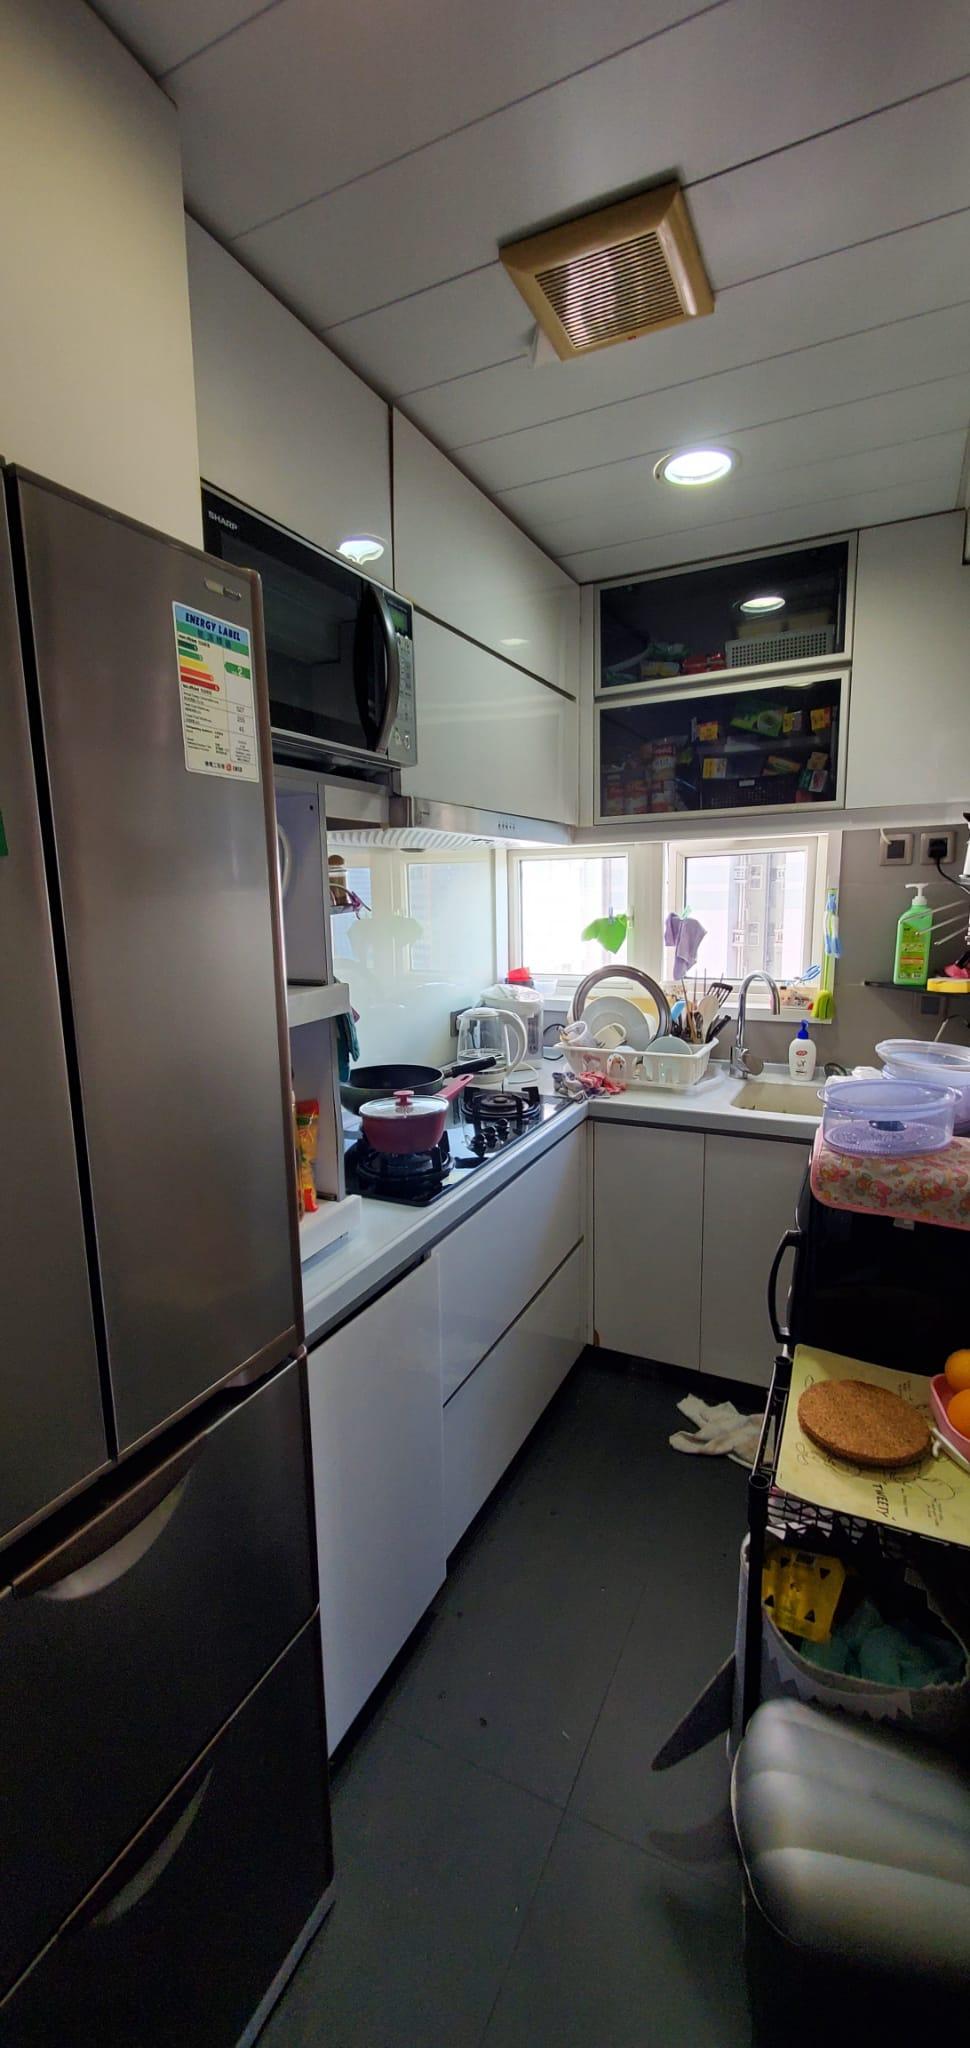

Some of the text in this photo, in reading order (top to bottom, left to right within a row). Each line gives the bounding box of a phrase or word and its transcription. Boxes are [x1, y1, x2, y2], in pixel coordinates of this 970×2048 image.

[208, 510, 238, 530] SHARP
[185, 612, 217, 632] ENERGY
[218, 625, 241, 642] LABEL
[872, 1484, 889, 1518] TWEETY
